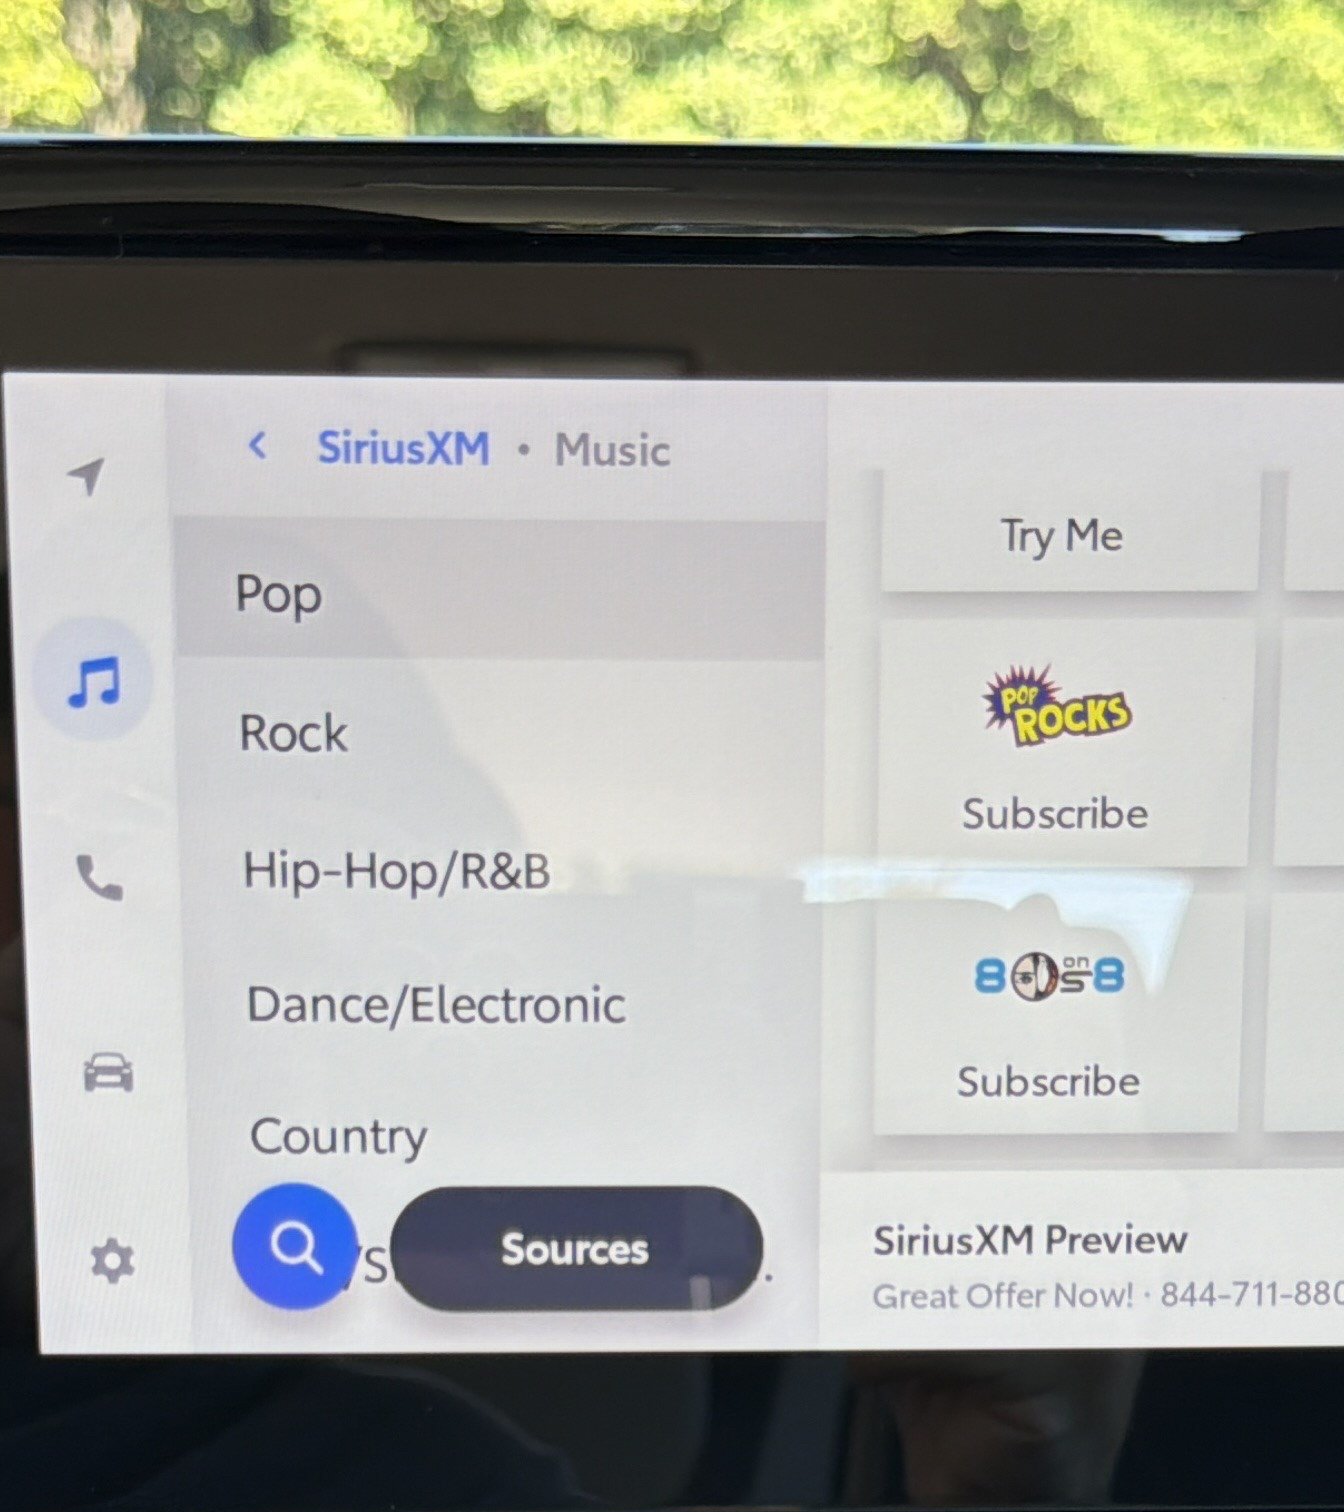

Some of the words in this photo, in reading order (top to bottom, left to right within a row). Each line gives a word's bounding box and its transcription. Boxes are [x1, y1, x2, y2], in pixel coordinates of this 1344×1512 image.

[319, 429, 489, 466] SiriusXM
[556, 431, 671, 467] Music
[1000, 518, 1055, 561] Try
[1066, 518, 1123, 552] Me
[237, 573, 323, 622] Pop
[1001, 685, 1038, 714] POP
[1015, 697, 1128, 742] ROCKS
[241, 711, 348, 753] Rock
[963, 795, 1149, 830] Subscribe
[245, 849, 550, 900] Hip-Hop/R&B
[248, 984, 626, 1031] Dance/Electronic
[958, 1063, 1140, 1098] Subscribe
[250, 1116, 429, 1164] Country
[502, 1230, 649, 1266] Sources
[874, 1223, 1033, 1256] SiriusXM
[1046, 1222, 1188, 1255] Preview
[873, 1283, 959, 1310] Great
[966, 1281, 1047, 1309] Offer
[1054, 1281, 1133, 1309] Now!
